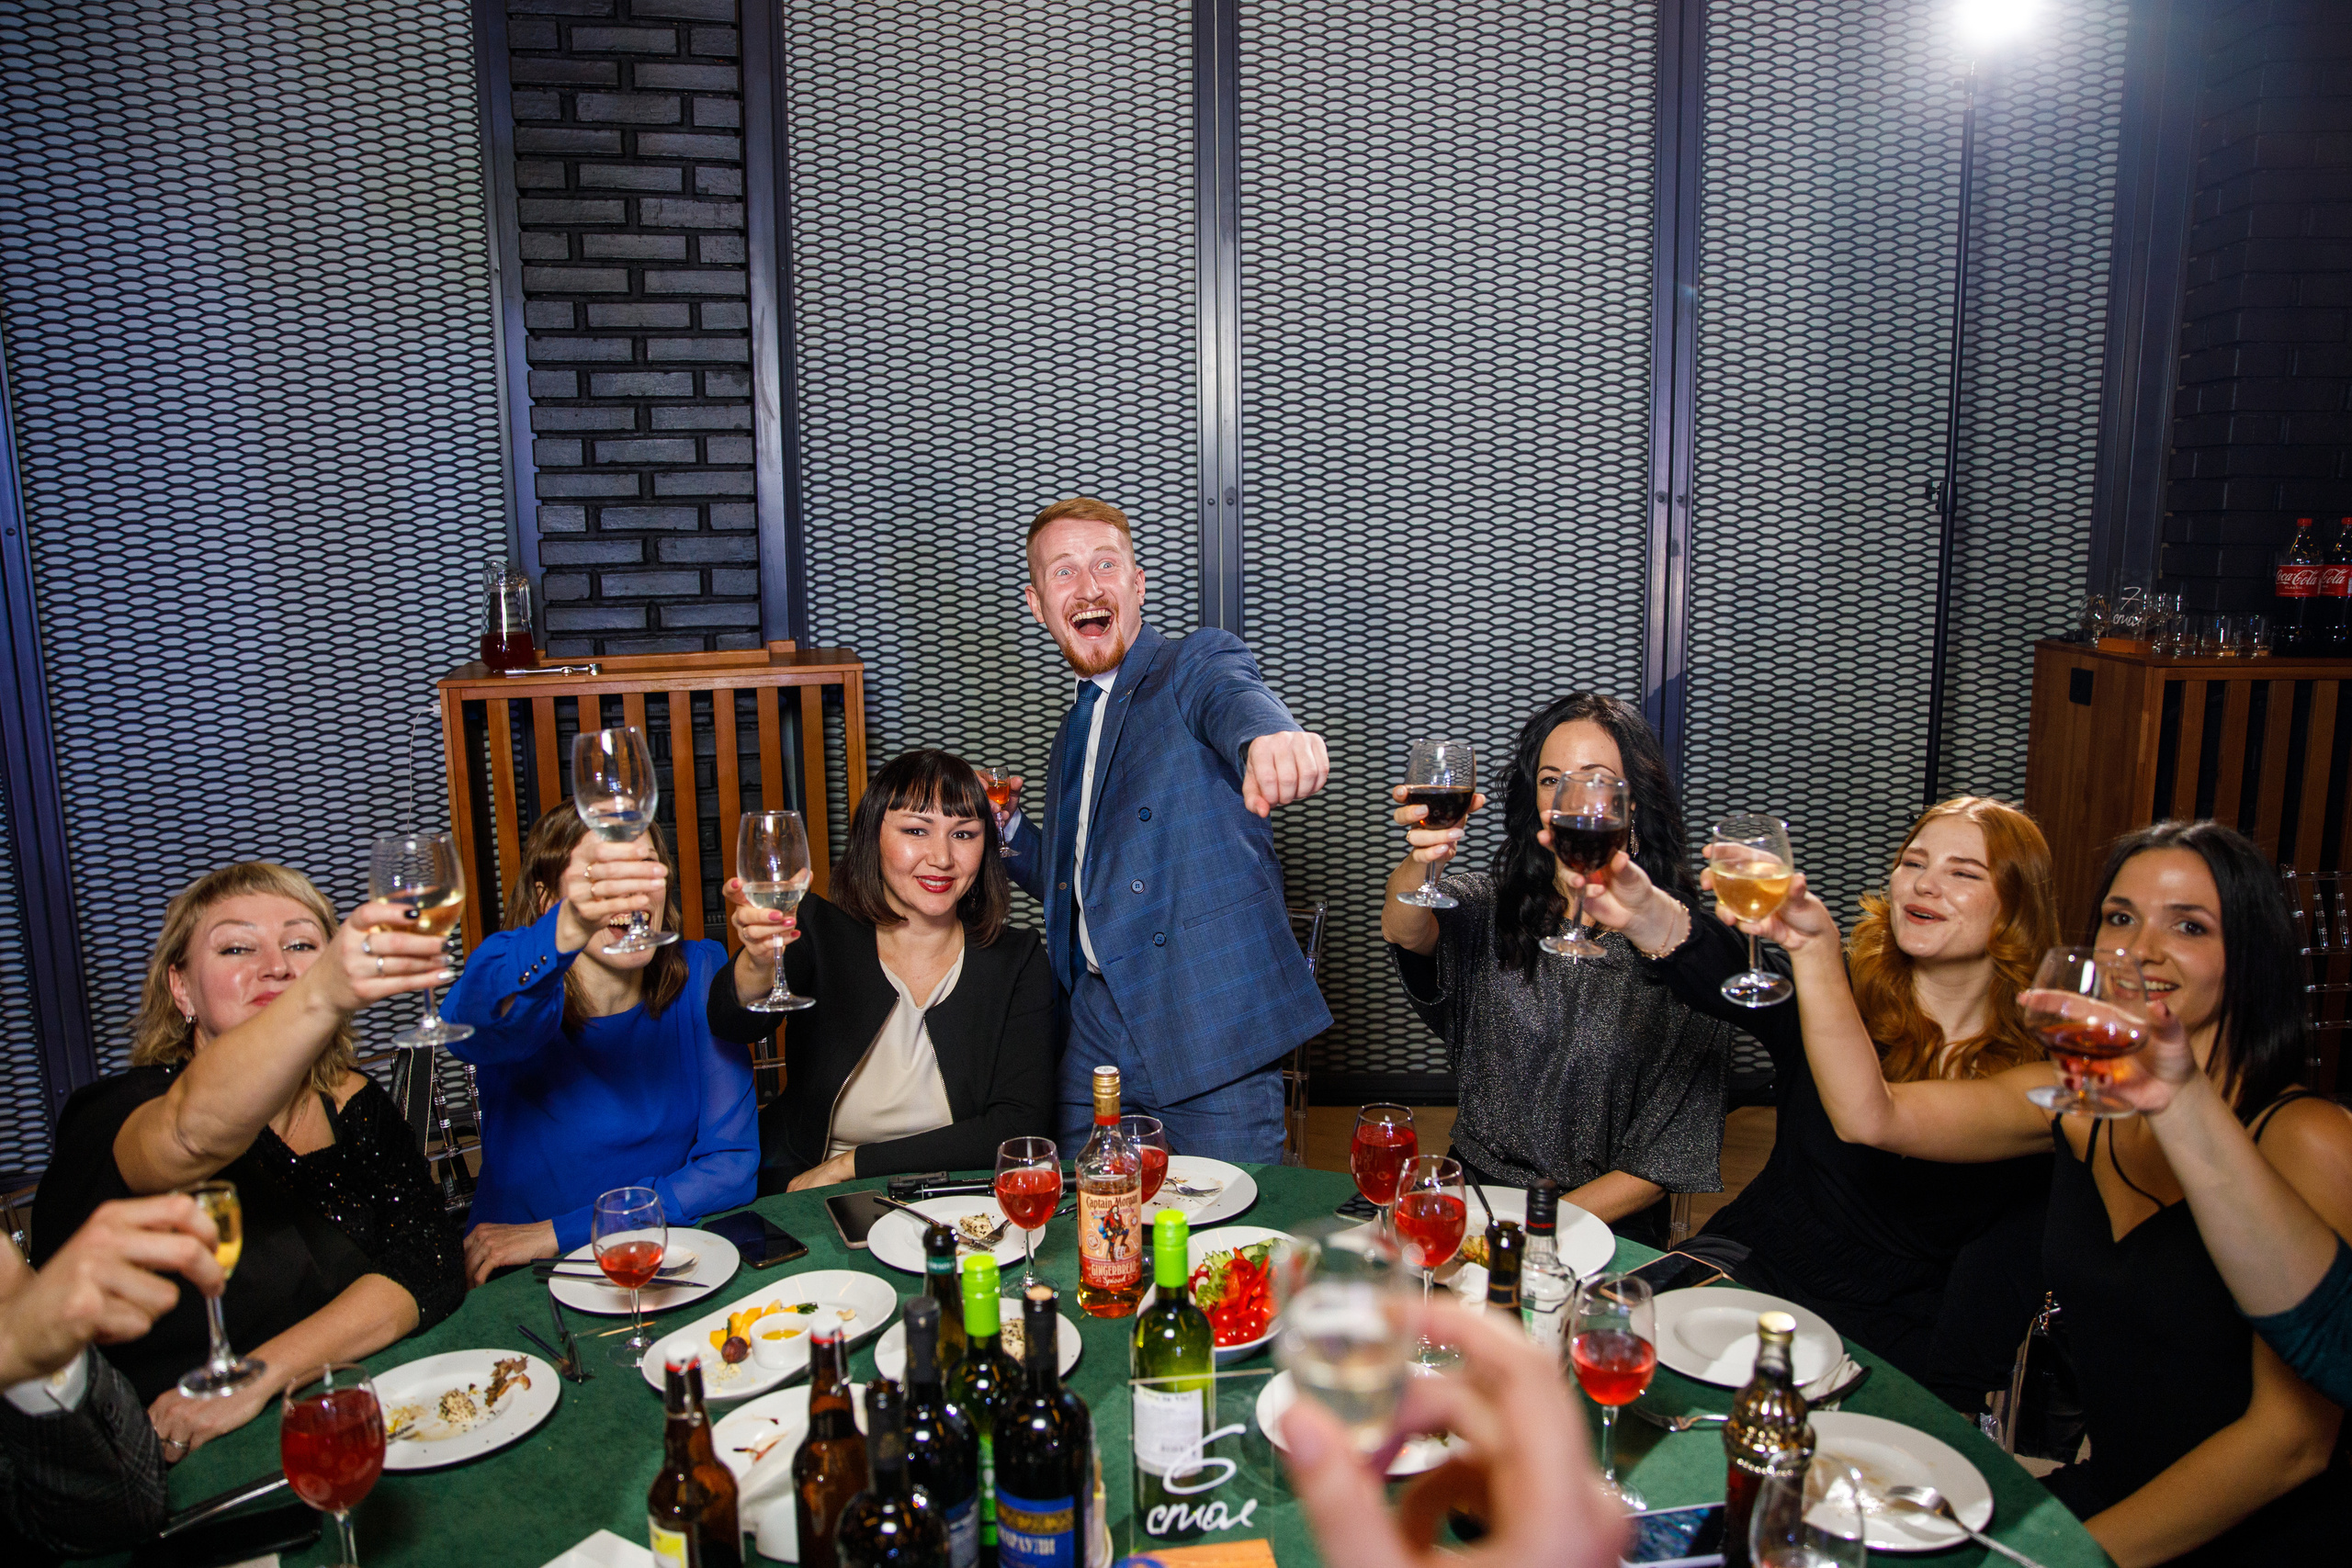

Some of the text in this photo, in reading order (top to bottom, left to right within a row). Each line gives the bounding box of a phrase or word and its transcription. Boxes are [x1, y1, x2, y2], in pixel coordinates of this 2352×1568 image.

[2120, 586, 2142, 611] 7
[1086, 1194, 1138, 1210] Captain Morgan
[1091, 1260, 1137, 1277] GINGERBREAD
